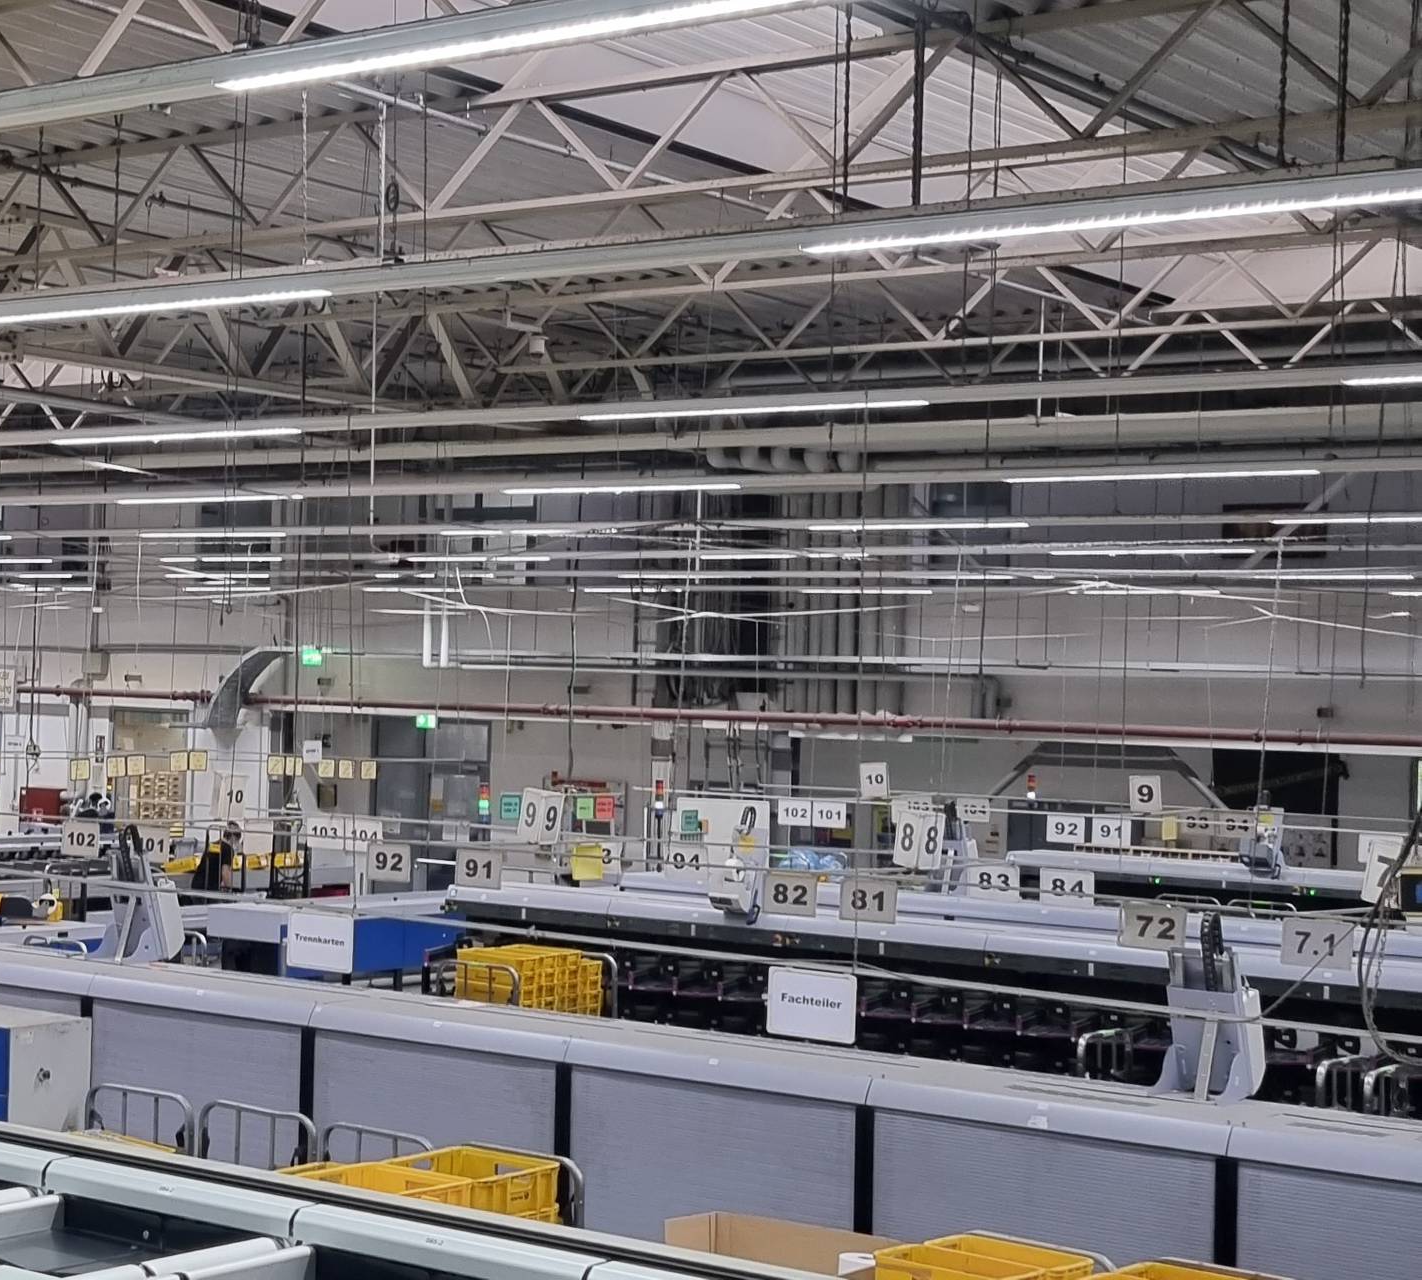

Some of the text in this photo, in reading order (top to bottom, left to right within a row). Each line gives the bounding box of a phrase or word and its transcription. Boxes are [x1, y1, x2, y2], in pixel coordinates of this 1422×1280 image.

[865, 773, 884, 785] 10
[227, 790, 244, 804] 10
[1137, 784, 1154, 803] 9
[524, 802, 558, 832] 9 9
[783, 807, 808, 819] 102
[817, 809, 842, 821] 101
[311, 825, 339, 840] 103
[1054, 822, 1078, 836] 92
[1100, 825, 1123, 840] 91
[66, 831, 96, 848] 102
[900, 823, 939, 855] 8 8
[375, 851, 404, 872] 92
[464, 859, 492, 880] 91
[672, 852, 700, 871] 94
[978, 871, 1011, 892] 83
[1051, 878, 1085, 898] 84
[772, 883, 809, 907] 82
[850, 888, 886, 913] 81
[1135, 914, 1177, 941] 72
[294, 932, 346, 948] Trennkarten
[1294, 930, 1337, 958] 7.1
[780, 992, 844, 1010] Fachteiler
